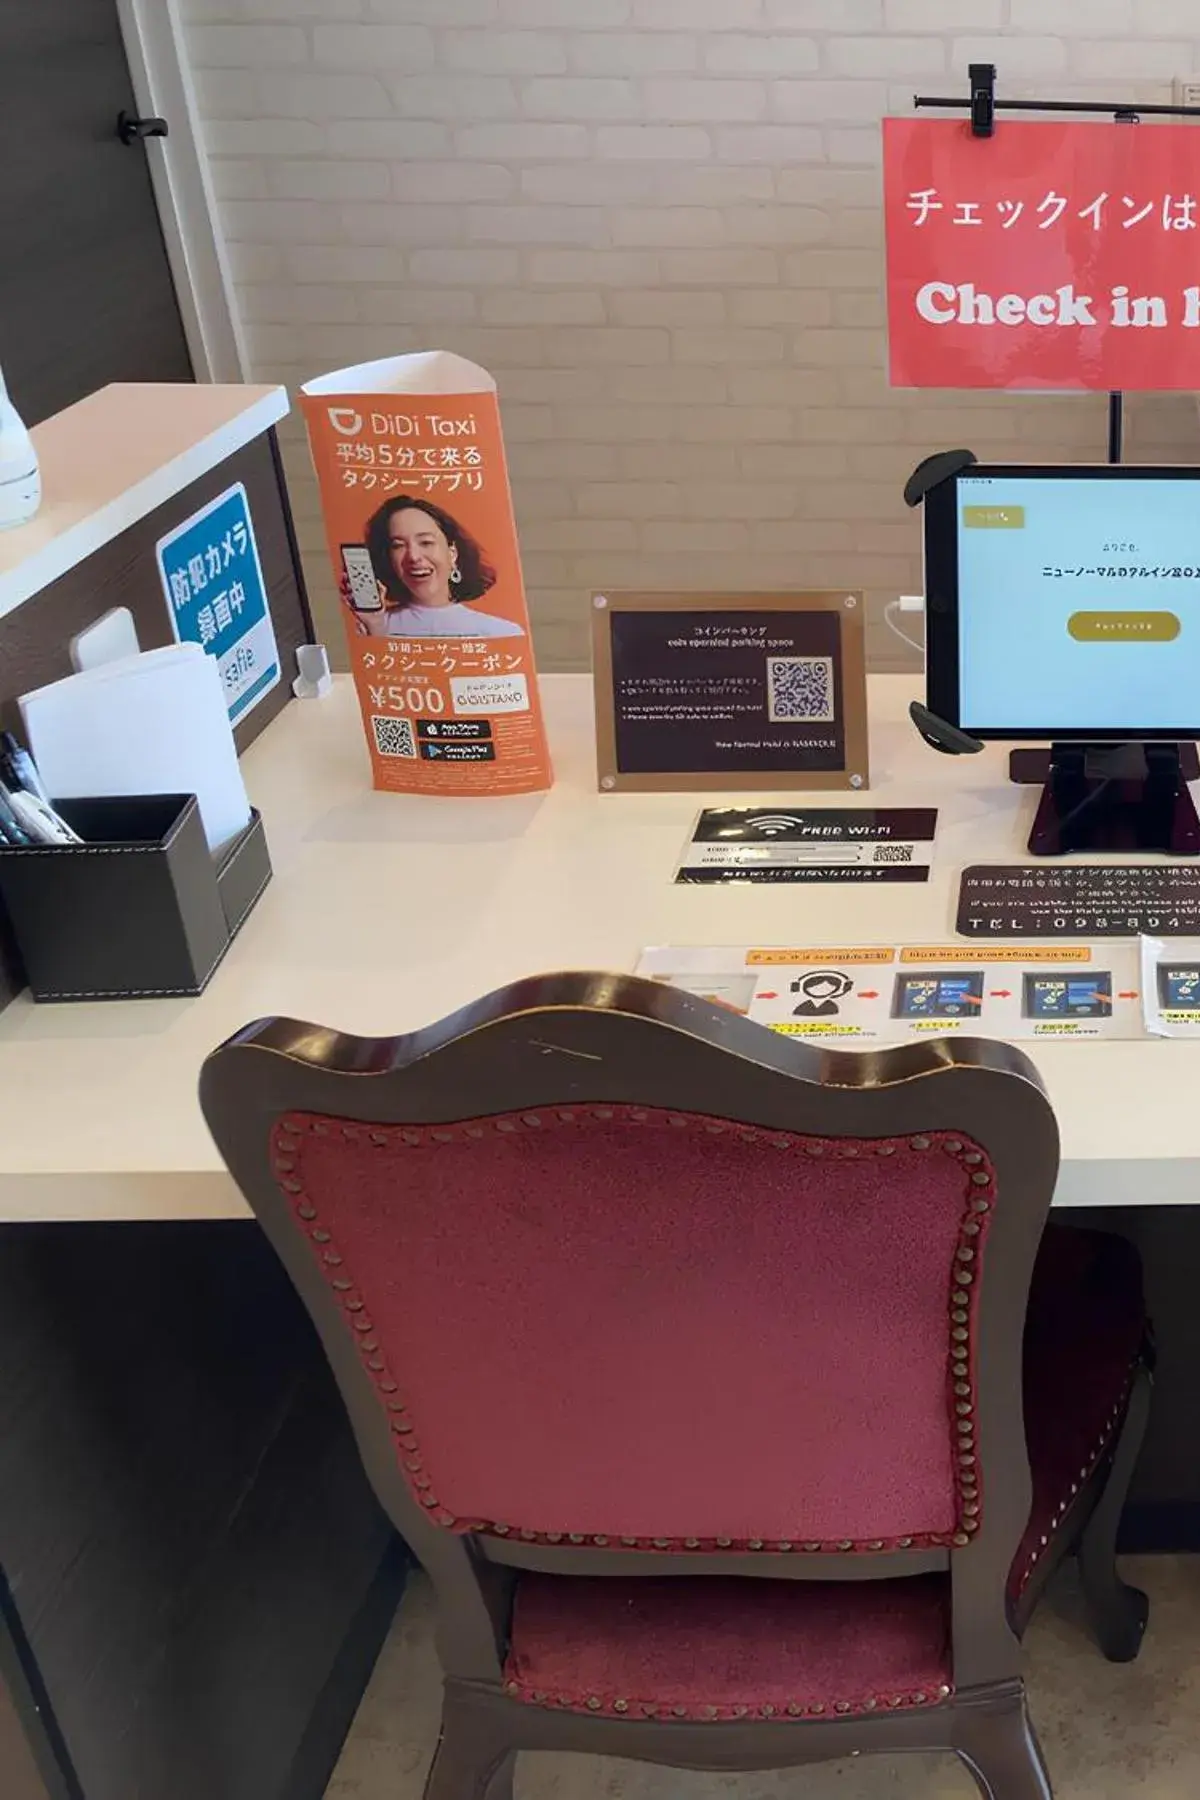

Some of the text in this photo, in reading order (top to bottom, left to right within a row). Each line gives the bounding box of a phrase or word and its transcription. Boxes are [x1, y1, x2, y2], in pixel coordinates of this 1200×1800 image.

[916, 282, 1096, 326] Check
[1108, 286, 1167, 327] in
[371, 412, 476, 436] DiDi Taxi
[336, 443, 482, 467] 平均5分で来る
[170, 521, 247, 610] 防犯カメラ
[363, 652, 523, 672] タクシークーポン
[368, 684, 445, 713] ¥500
